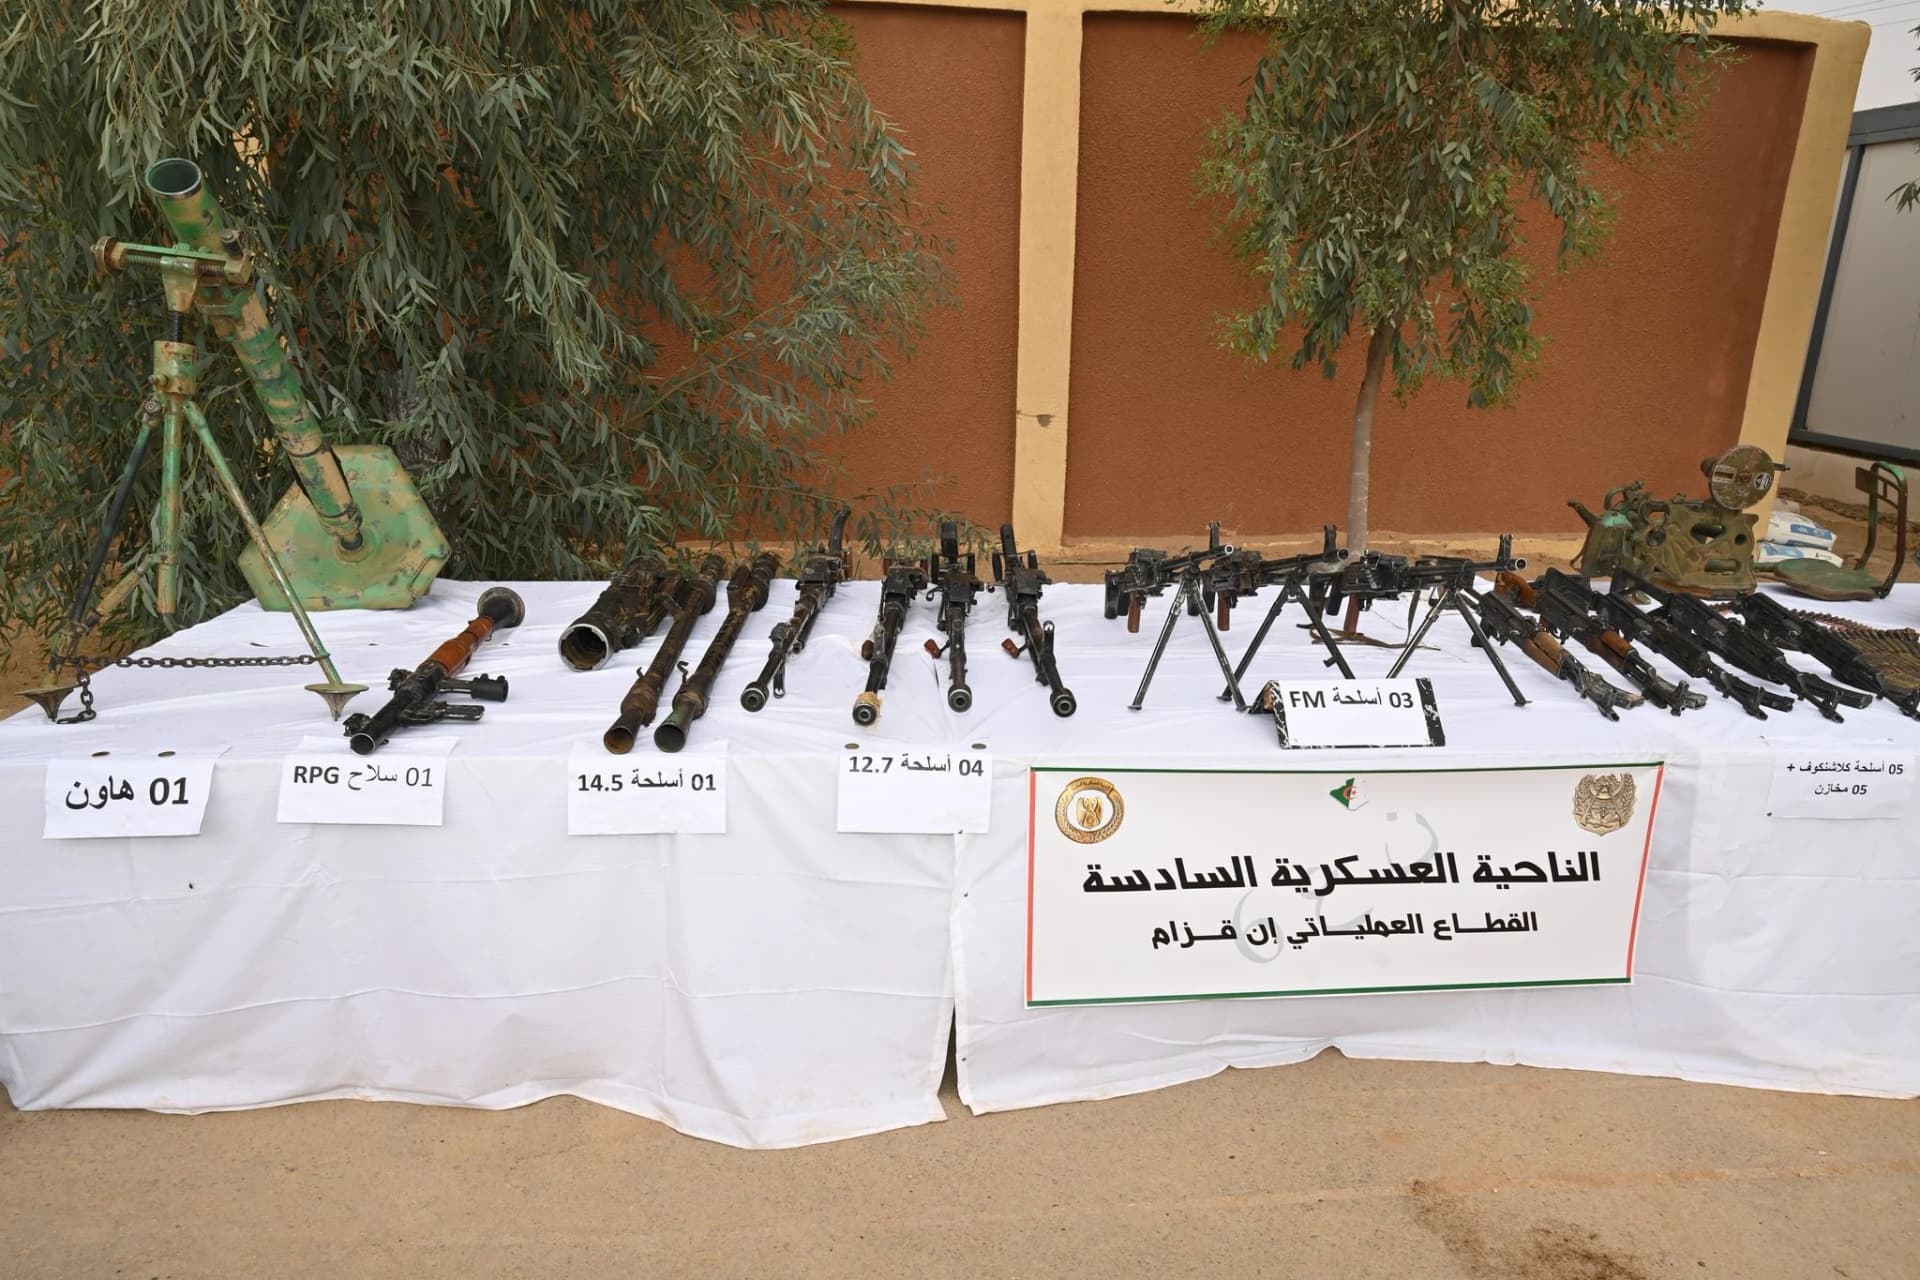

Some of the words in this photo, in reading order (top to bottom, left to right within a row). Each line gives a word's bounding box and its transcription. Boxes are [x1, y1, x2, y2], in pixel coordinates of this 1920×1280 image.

[1289, 690, 1326, 709] FM
[1332, 686, 1382, 705] أسلحة
[1388, 691, 1414, 709] 03
[849, 756, 894, 774] 12.7
[900, 753, 951, 772] أسلحة
[958, 759, 984, 777] 04
[1888, 763, 1904, 775] 05
[293, 765, 340, 785] RPG
[347, 764, 398, 791] سلاح
[405, 767, 433, 787] 01
[577, 774, 624, 792] 14.5
[631, 768, 684, 788] أسلحة
[691, 773, 717, 792] 01
[65, 775, 135, 810] هاون
[149, 777, 189, 806] 01
[1814, 783, 1849, 796] مخازن
[1851, 784, 1868, 795] 05
[1083, 855, 1258, 893] السادسة
[1271, 852, 1460, 897] العسكرية
[1472, 851, 1601, 890] الناحية
[1151, 920, 1238, 950] قزام
[1246, 917, 1278, 946] إن
[1286, 913, 1424, 950] العملياتي
[1433, 911, 1538, 941] القطاع
